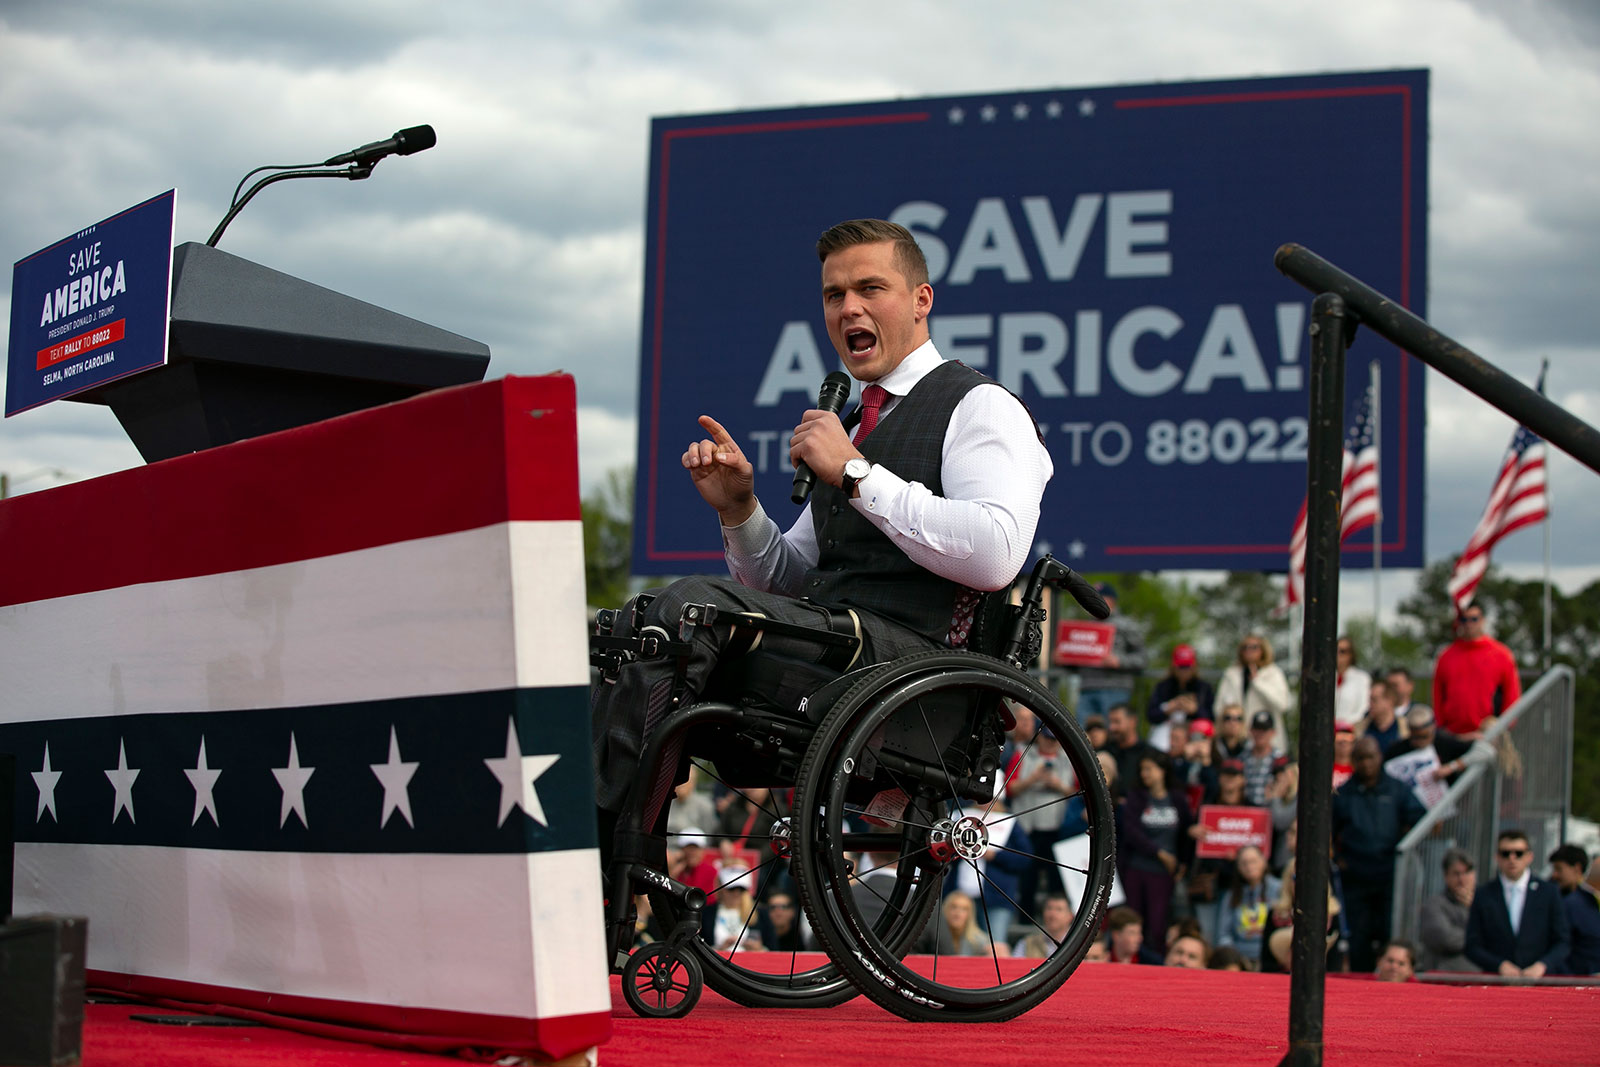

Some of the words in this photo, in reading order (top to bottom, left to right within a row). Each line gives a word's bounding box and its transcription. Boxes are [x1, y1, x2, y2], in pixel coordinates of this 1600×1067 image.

[69, 241, 102, 276] SAVE
[889, 190, 1172, 285] SAVE
[40, 260, 126, 327] AMERICA
[48, 322, 72, 339] PRESIDENT
[73, 314, 92, 329] DONALD
[98, 305, 114, 319] TRUMP
[50, 346, 64, 360] TEXT
[64, 339, 82, 355] RALLY
[83, 336, 91, 348] TO
[92, 329, 110, 345] 88022
[754, 303, 1305, 406] AERICA!
[43, 370, 63, 386] SELMA,
[64, 362, 84, 379] NORTH
[84, 351, 115, 371] CAROLINA
[1061, 421, 1132, 466] TO
[1147, 416, 1309, 464] 88022
